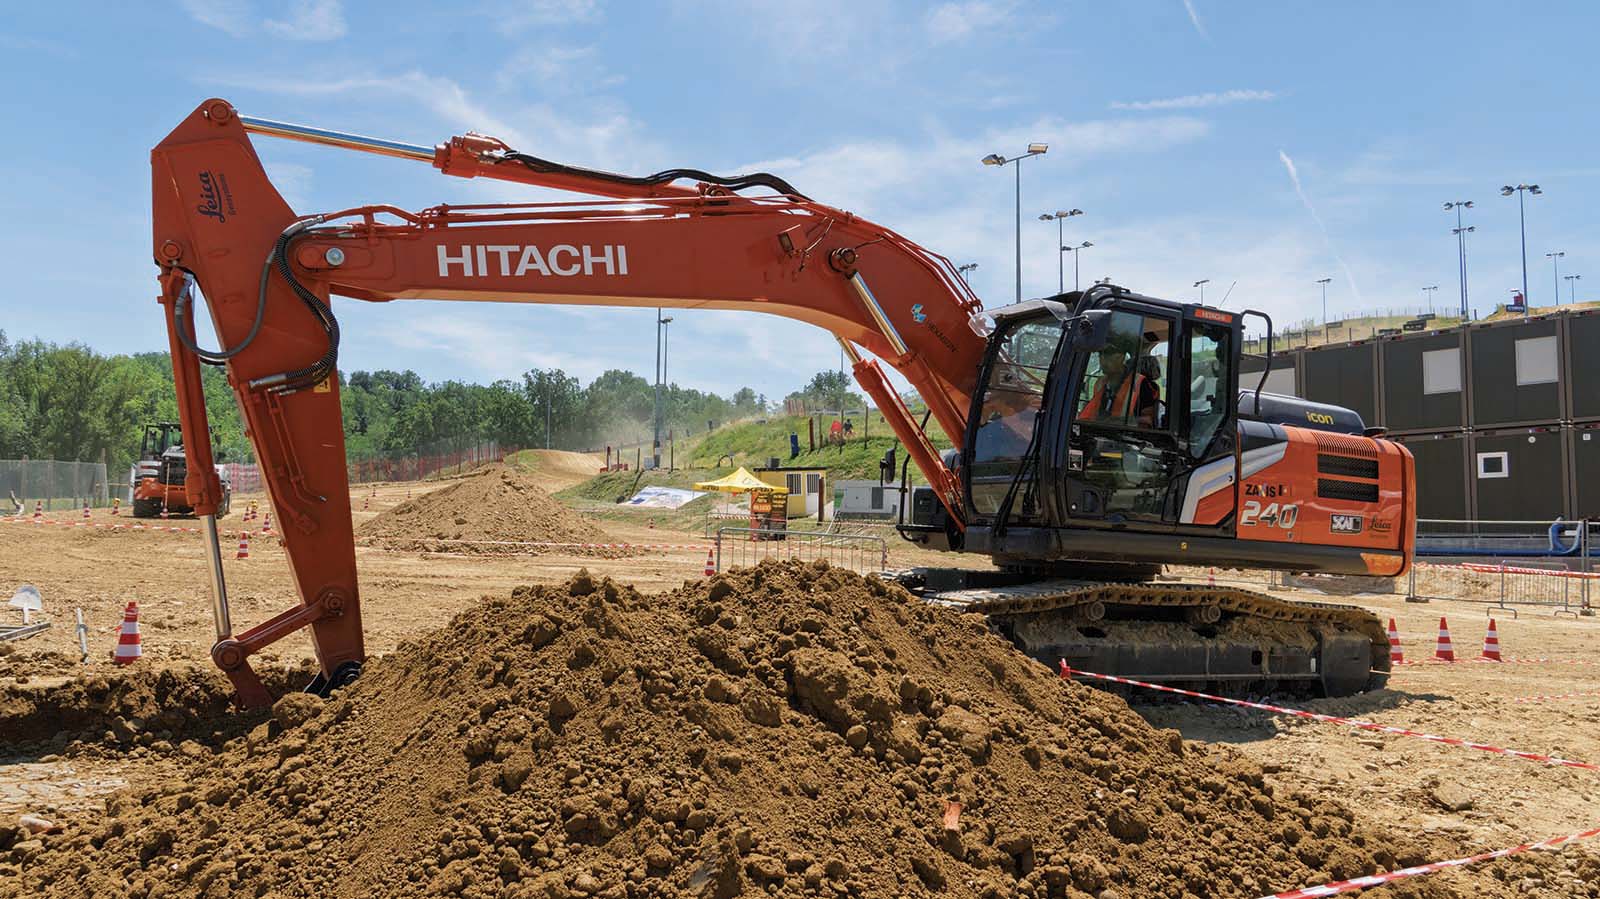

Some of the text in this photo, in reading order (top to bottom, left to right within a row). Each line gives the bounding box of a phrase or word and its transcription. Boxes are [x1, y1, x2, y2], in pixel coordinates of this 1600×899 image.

[197, 170, 226, 223] Leica
[436, 244, 629, 278] HITACHI
[1305, 411, 1335, 425] icon
[1240, 500, 1299, 529] 240
